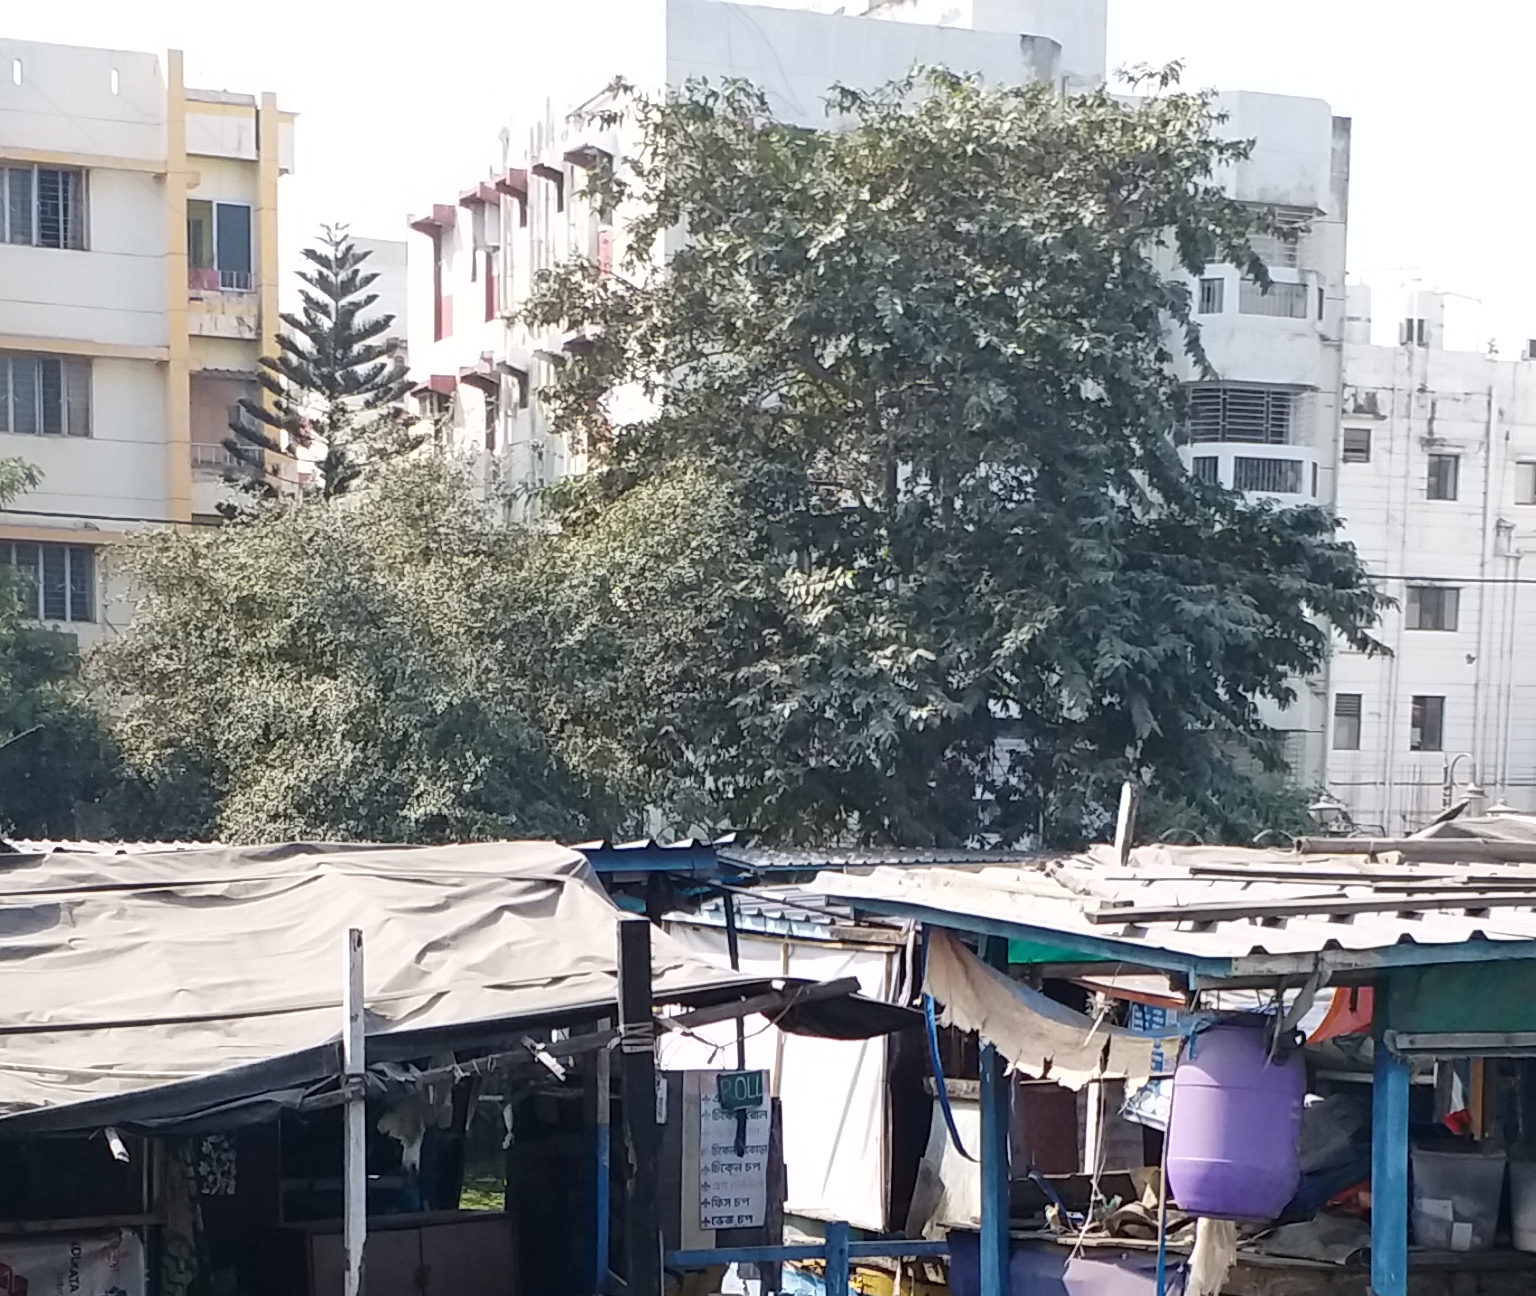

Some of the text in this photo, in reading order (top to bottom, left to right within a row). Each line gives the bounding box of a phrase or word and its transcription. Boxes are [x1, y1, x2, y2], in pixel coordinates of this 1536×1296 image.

[721, 1075, 764, 1101] ROLL
[745, 1162, 761, 1173] চপ
[734, 1197, 750, 1207] চপ
[737, 1214, 753, 1225] চপ
